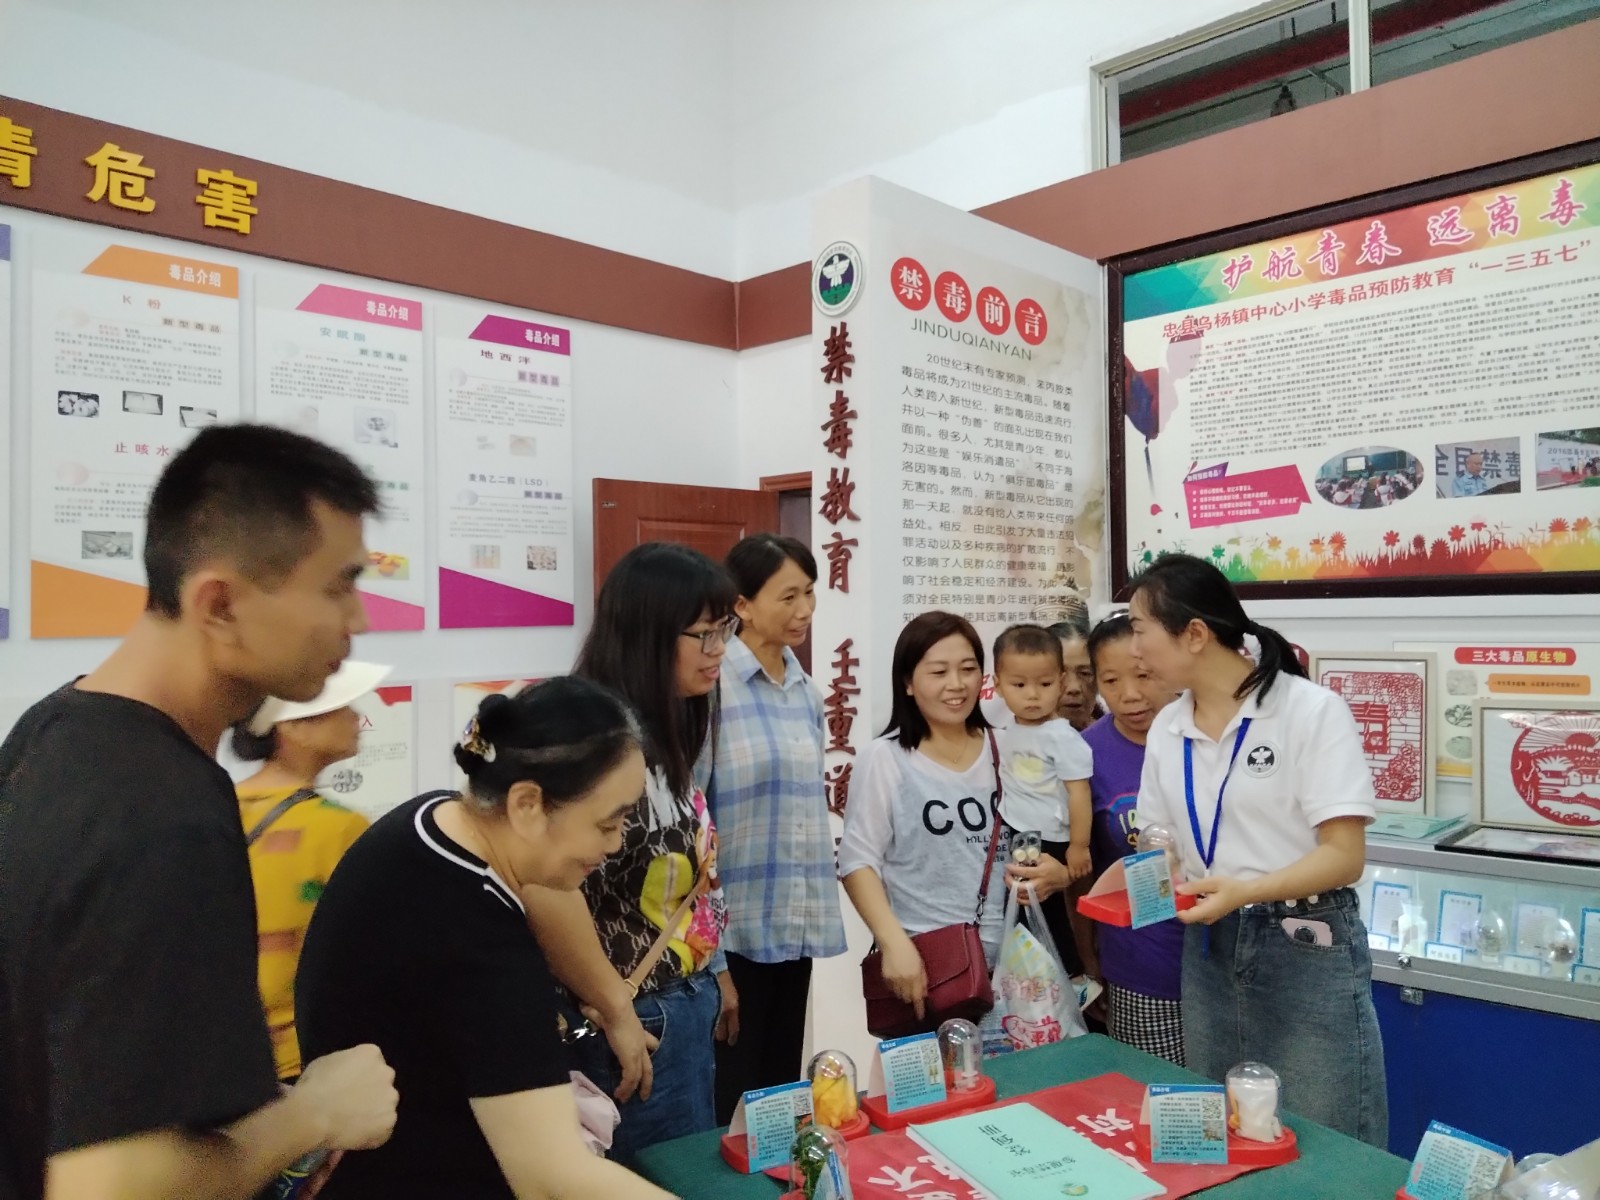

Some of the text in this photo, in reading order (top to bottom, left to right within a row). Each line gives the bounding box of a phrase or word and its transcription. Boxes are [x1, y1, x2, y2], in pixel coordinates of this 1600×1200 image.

[1222, 178, 1585, 293] 护航青春 远离毒
[169, 263, 222, 288] 毒品介绍
[366, 300, 409, 321] 毒品介绍
[898, 265, 1043, 337] 禁毒前言
[524, 328, 560, 347] 毒品介绍
[910, 318, 1032, 361] JINDUQIANYAN
[819, 321, 861, 594] 禁毒教育
[1472, 650, 1567, 663] 三大毒品原生物
